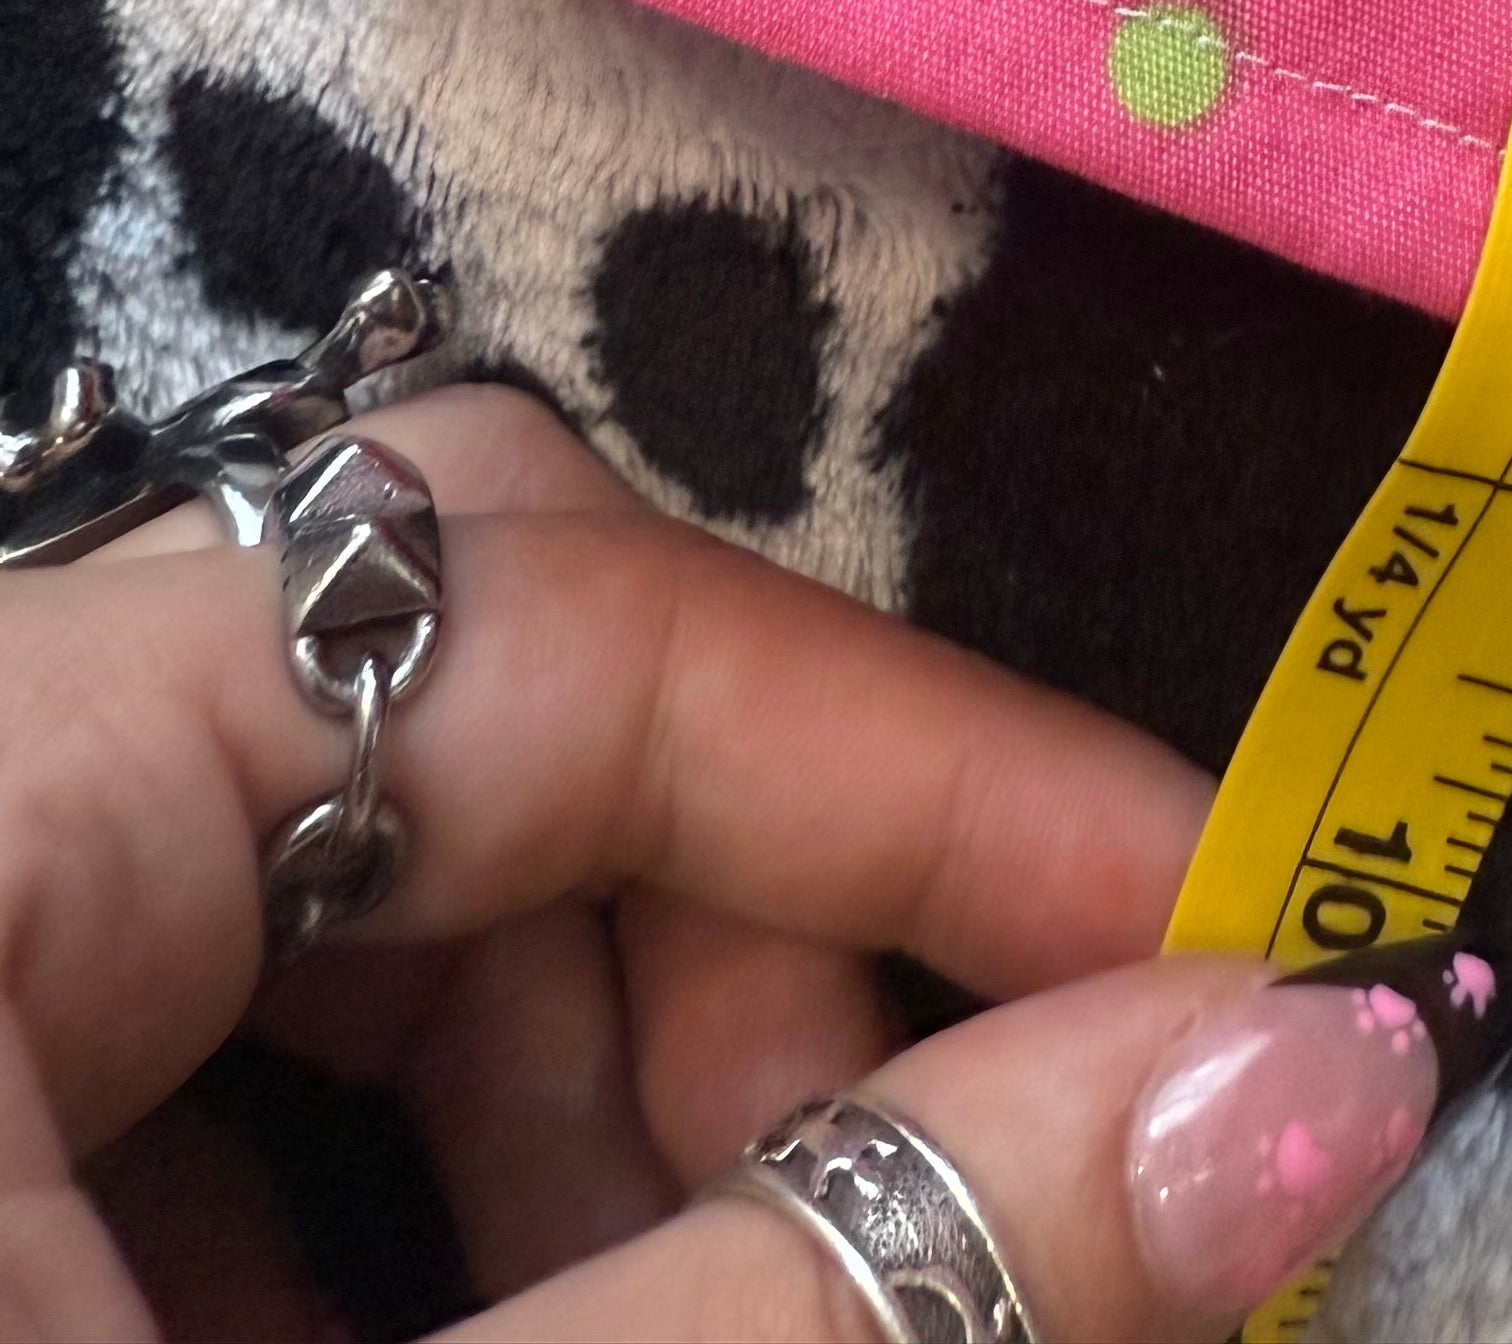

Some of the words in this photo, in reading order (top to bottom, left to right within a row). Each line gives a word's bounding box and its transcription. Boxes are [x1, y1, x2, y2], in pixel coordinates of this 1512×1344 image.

[1368, 503, 1458, 587] 1/4
[1316, 597, 1387, 681] yd
[1302, 821, 1412, 949] 10
